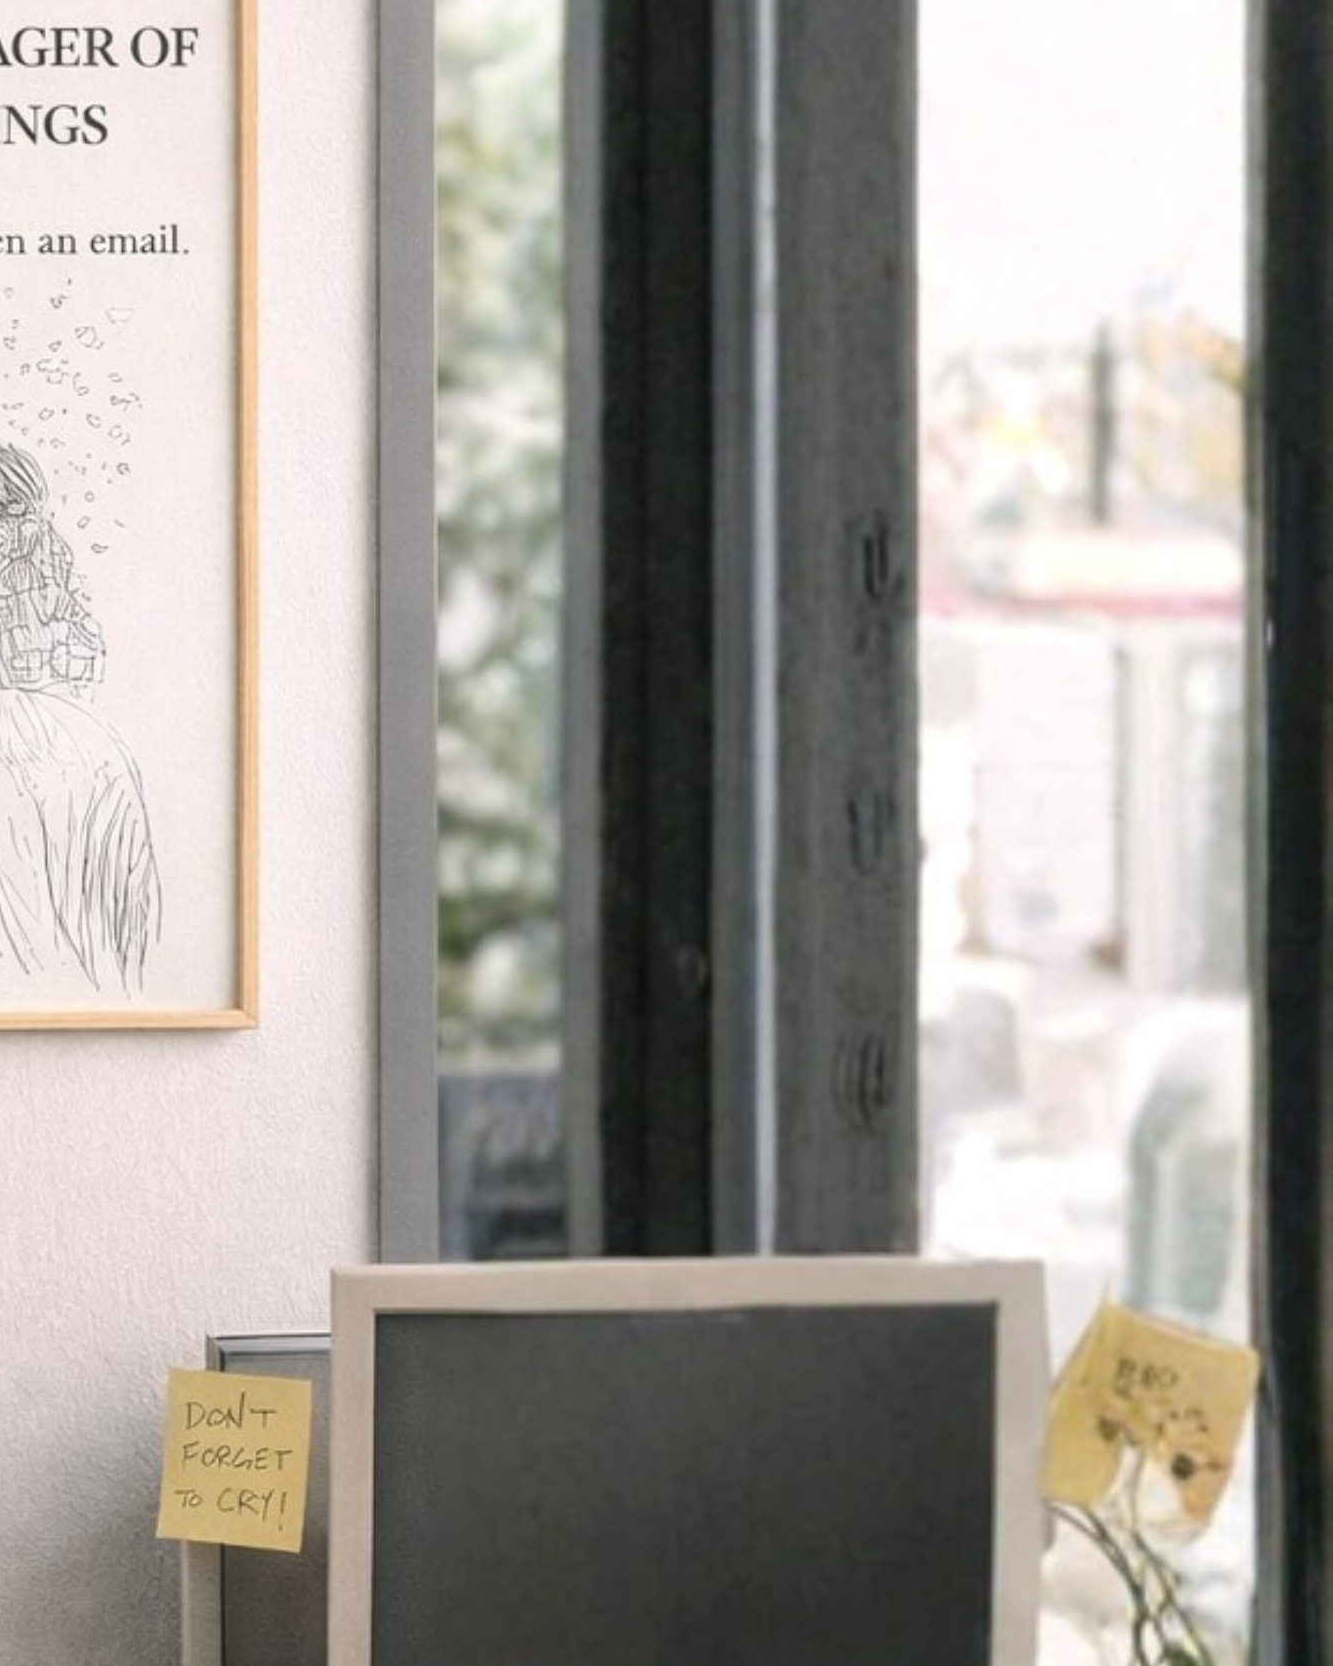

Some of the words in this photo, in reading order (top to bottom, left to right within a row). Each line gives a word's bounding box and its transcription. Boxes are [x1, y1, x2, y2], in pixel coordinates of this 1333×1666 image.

[130, 26, 200, 69] OF
[37, 233, 79, 257] an
[90, 224, 191, 257] email.
[183, 1441, 293, 1471] FORGET
[216, 1487, 287, 1533] CRY!
